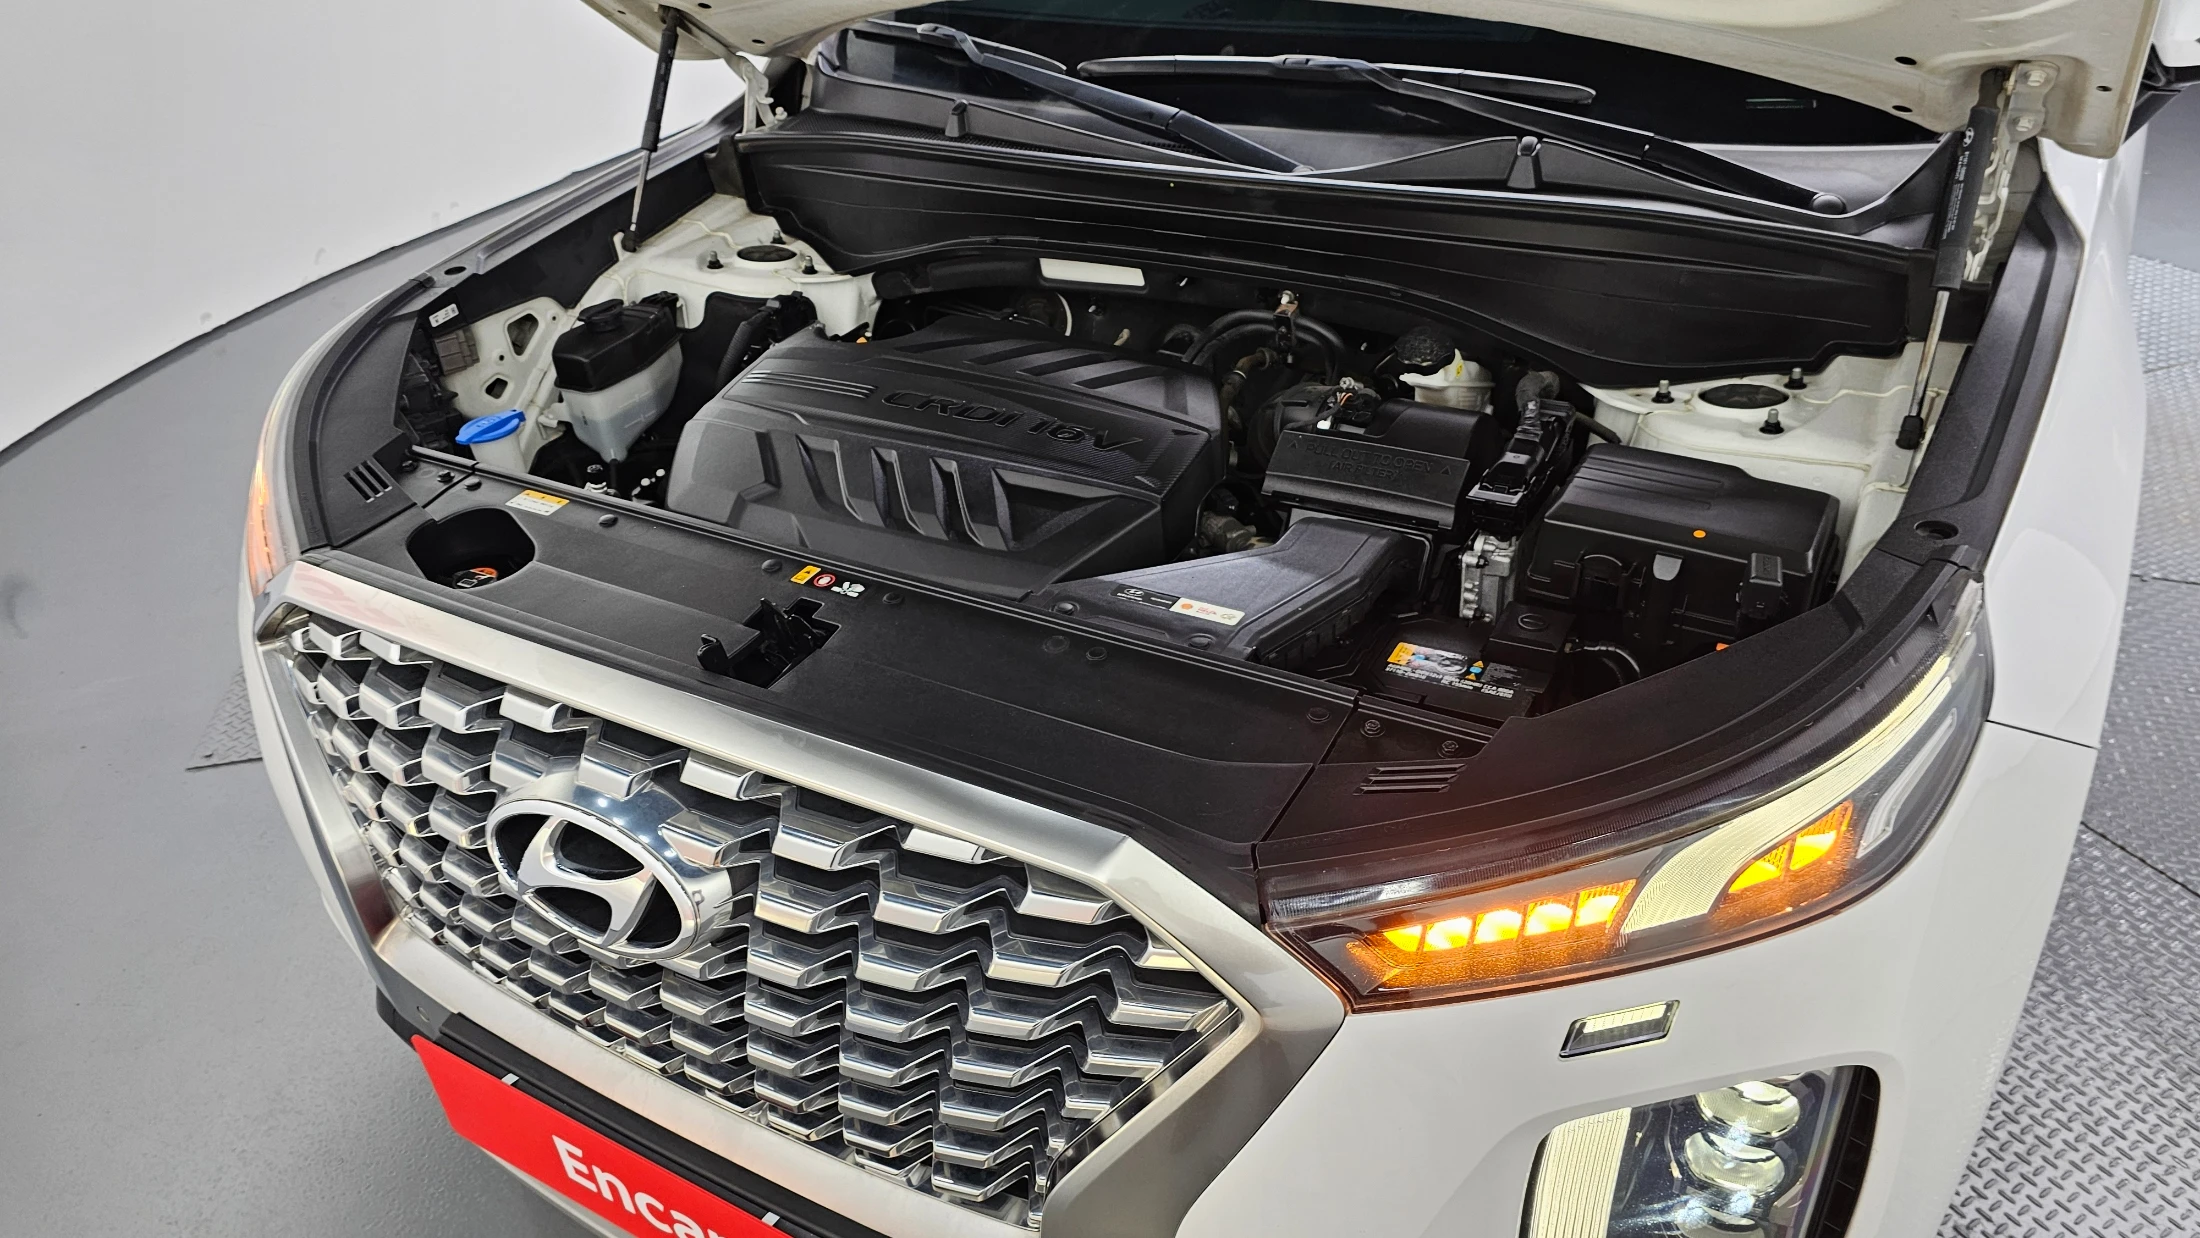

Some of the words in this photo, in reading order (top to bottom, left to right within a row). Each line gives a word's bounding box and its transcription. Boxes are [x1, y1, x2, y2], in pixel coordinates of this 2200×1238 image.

[1304, 441, 1338, 458] PULL
[1341, 447, 1371, 462] OUT
[1372, 452, 1392, 467] TO
[1393, 456, 1434, 474] OPEN
[552, 1134, 726, 1238] Enca
